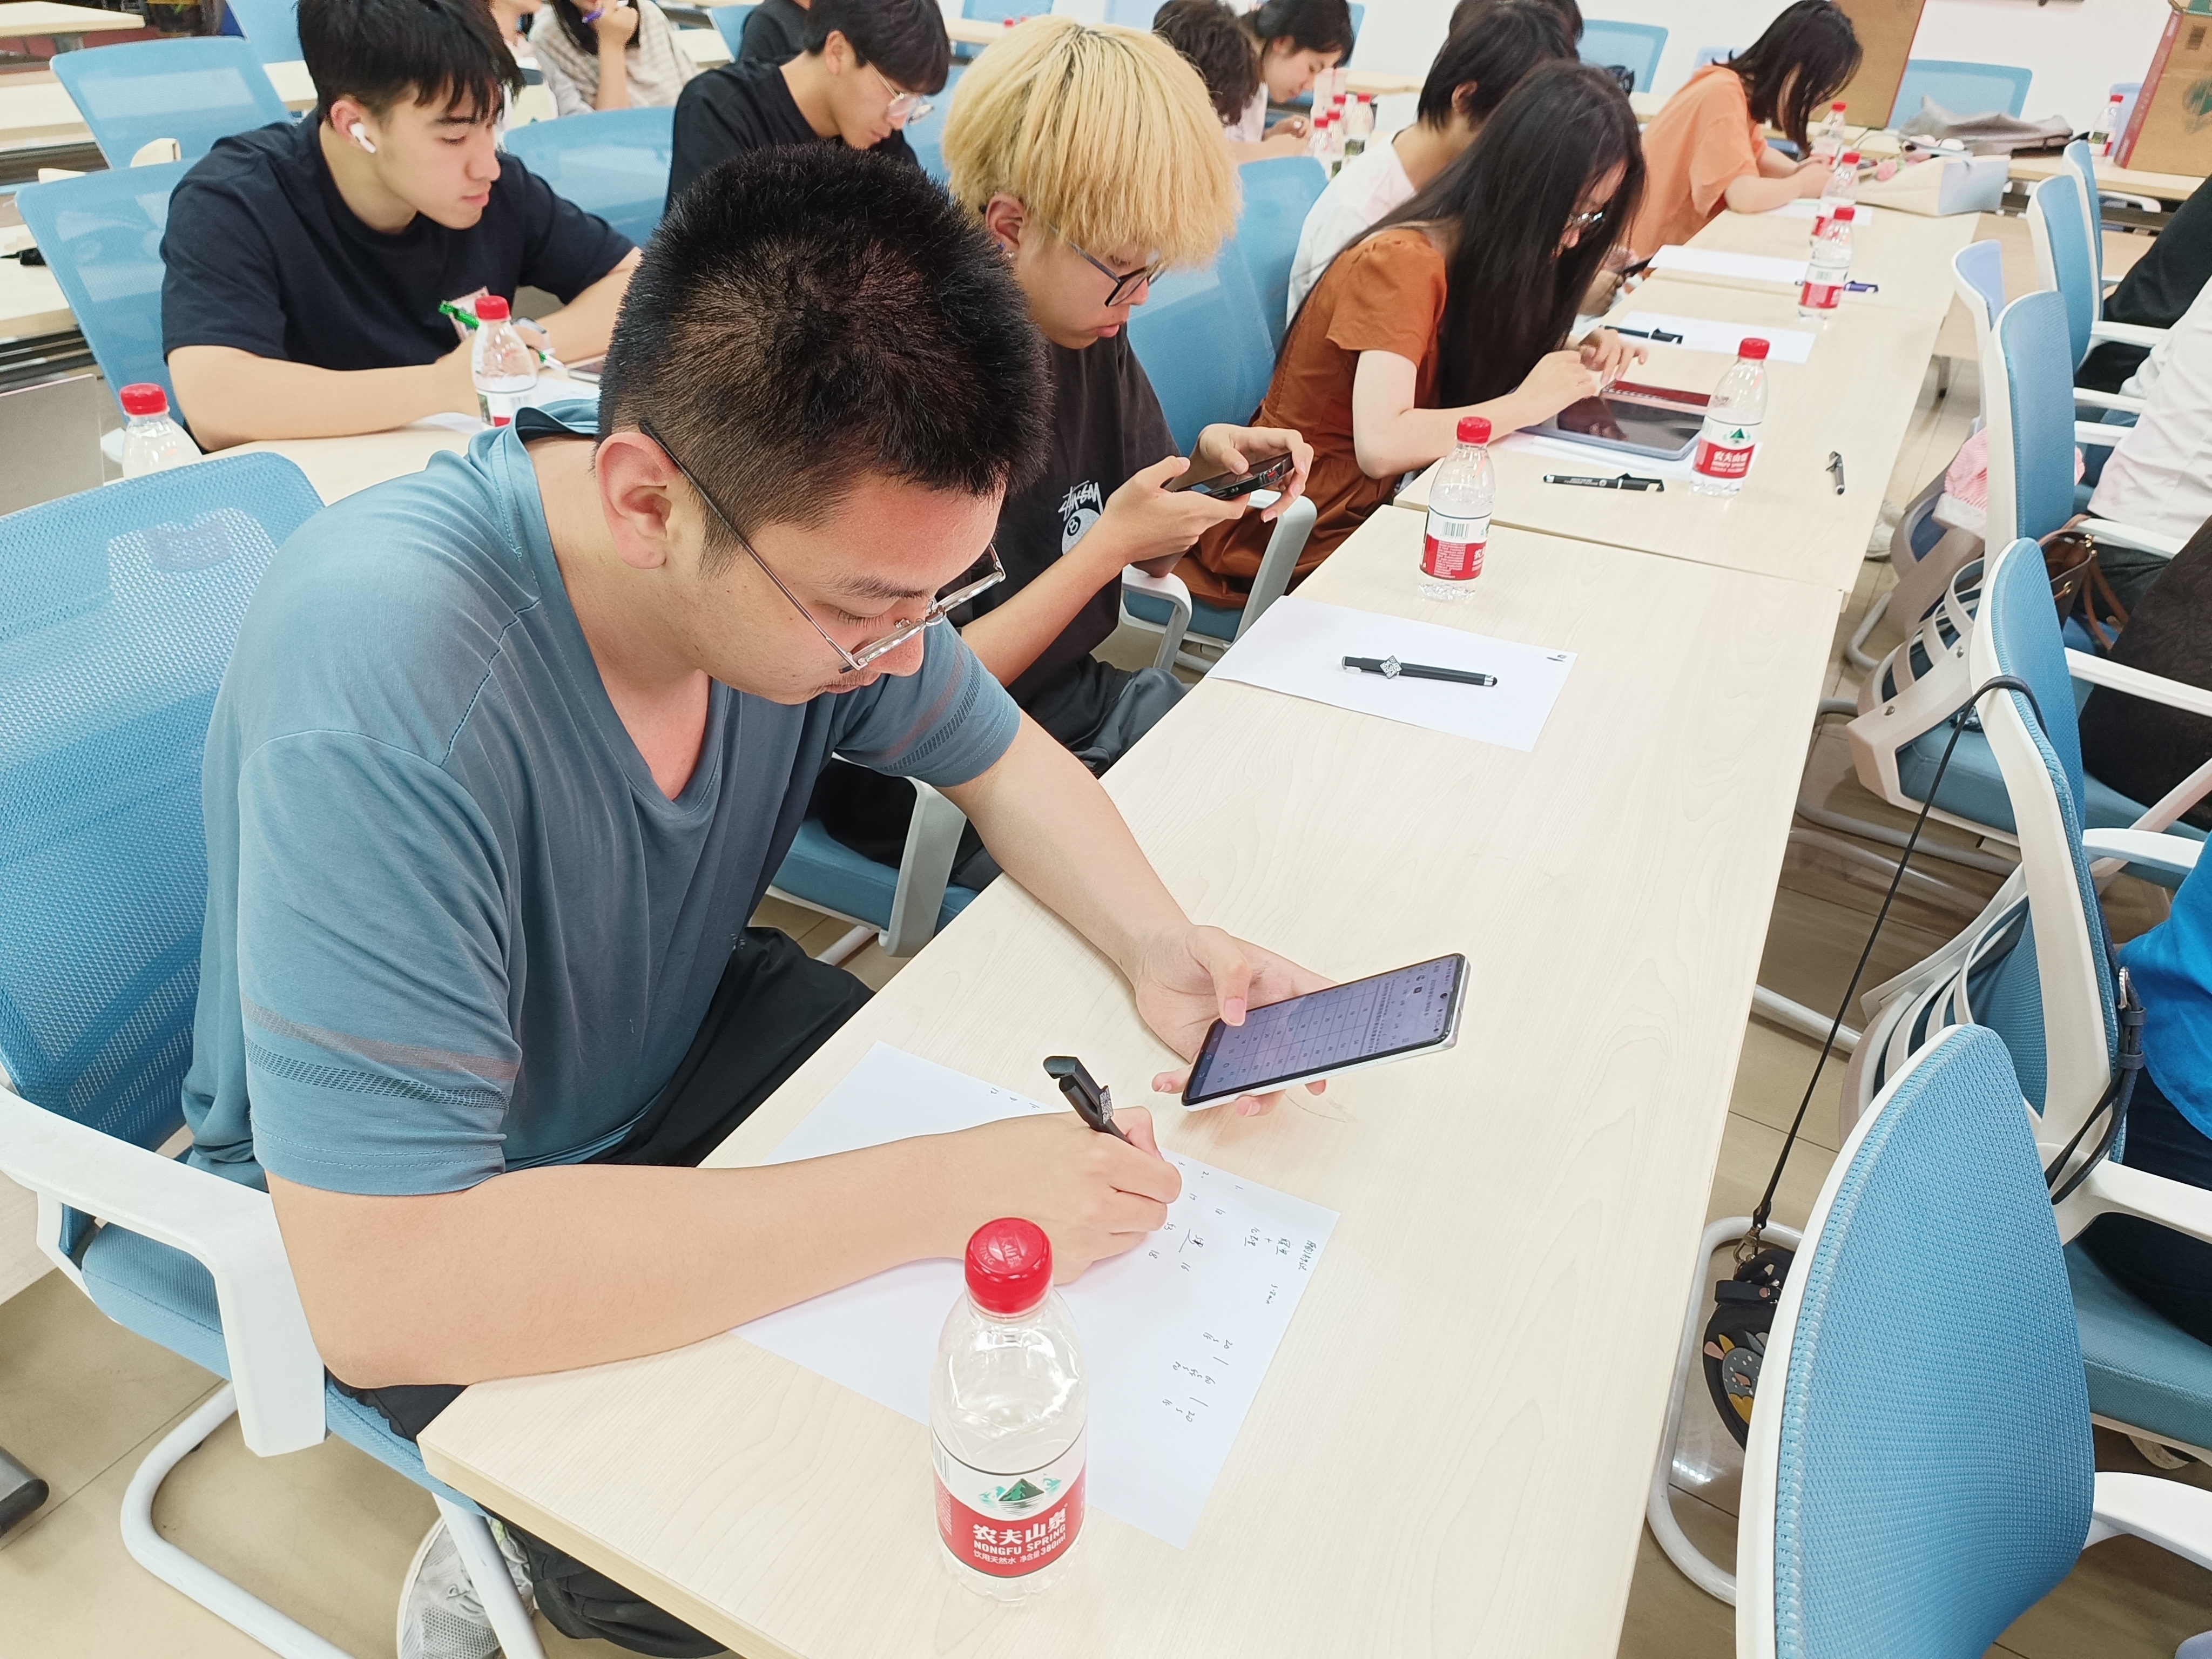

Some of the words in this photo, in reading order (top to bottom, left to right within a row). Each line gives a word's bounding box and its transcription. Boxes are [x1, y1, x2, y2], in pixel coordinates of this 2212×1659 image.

[973, 1503, 1068, 1545] 农夫山泉
[974, 1540, 1022, 1555] NONGFU
[1027, 1523, 1065, 1552] SPRING
[973, 1549, 1016, 1564] 饮用天然水
